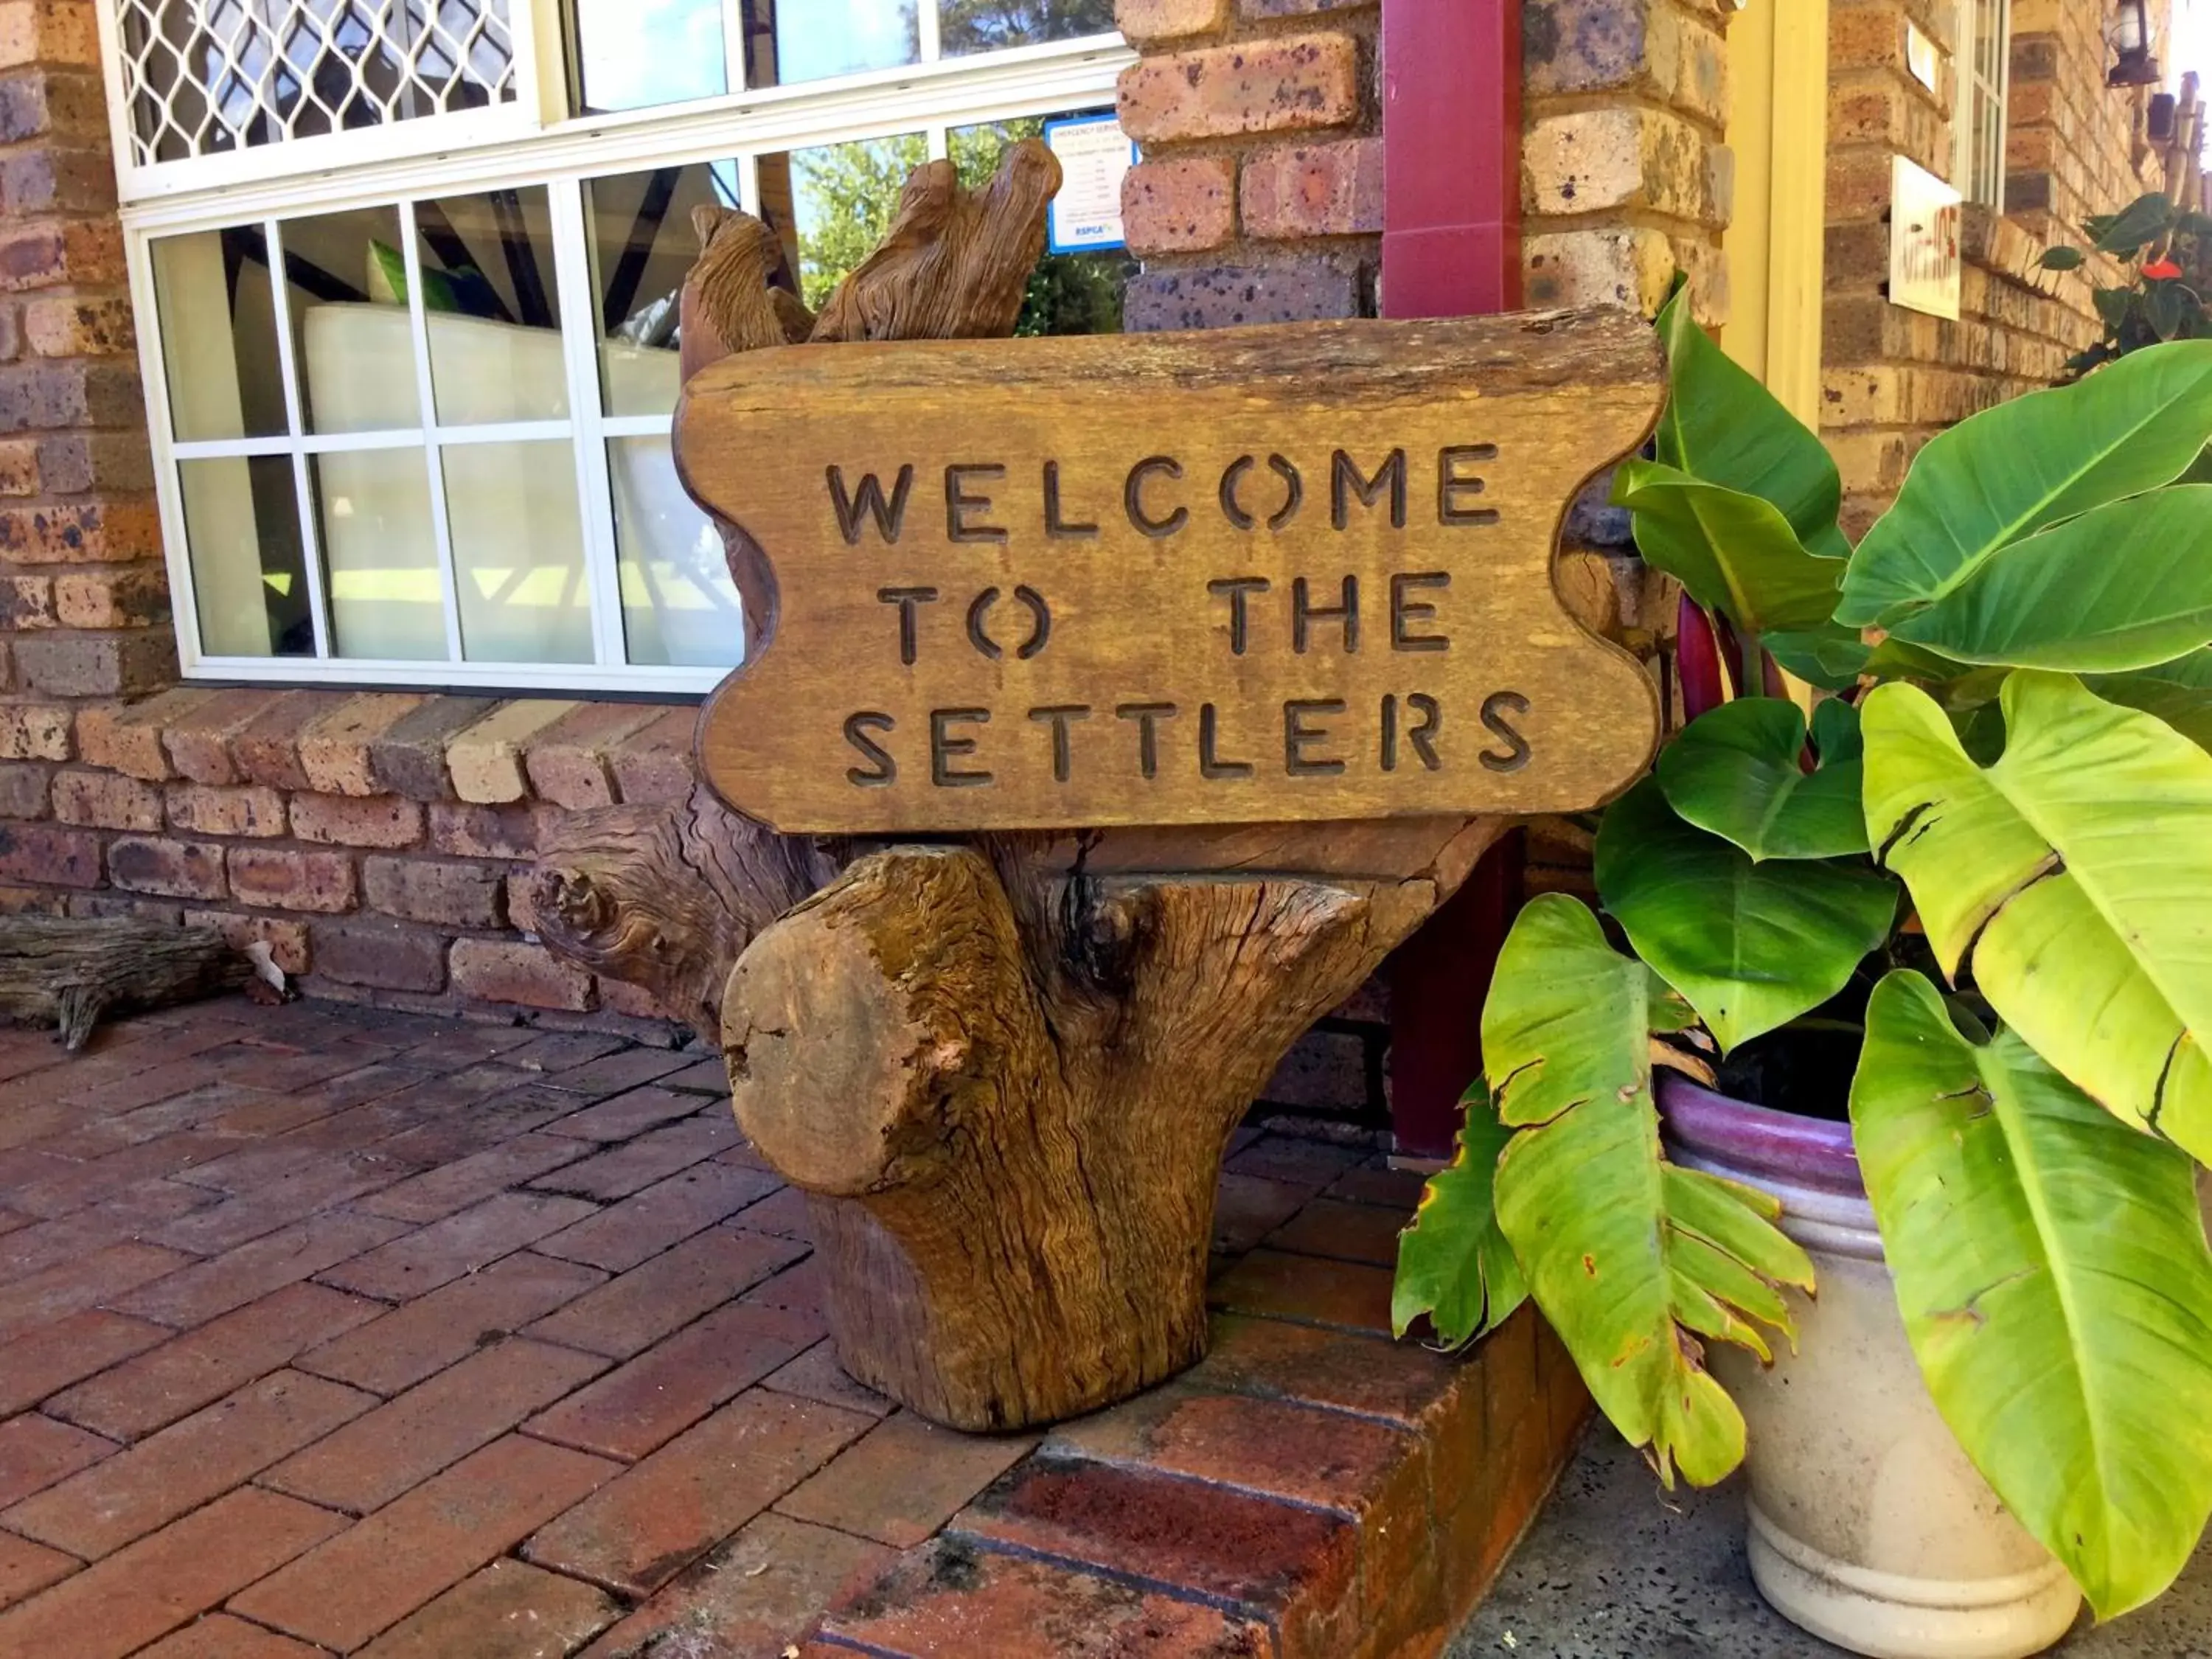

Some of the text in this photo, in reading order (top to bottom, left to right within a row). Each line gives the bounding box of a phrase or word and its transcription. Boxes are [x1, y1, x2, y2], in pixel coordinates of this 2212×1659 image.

[826, 443, 1500, 545] WELCOME
[877, 571, 1452, 666] TO THE
[842, 691, 1531, 787] SETTLERS
